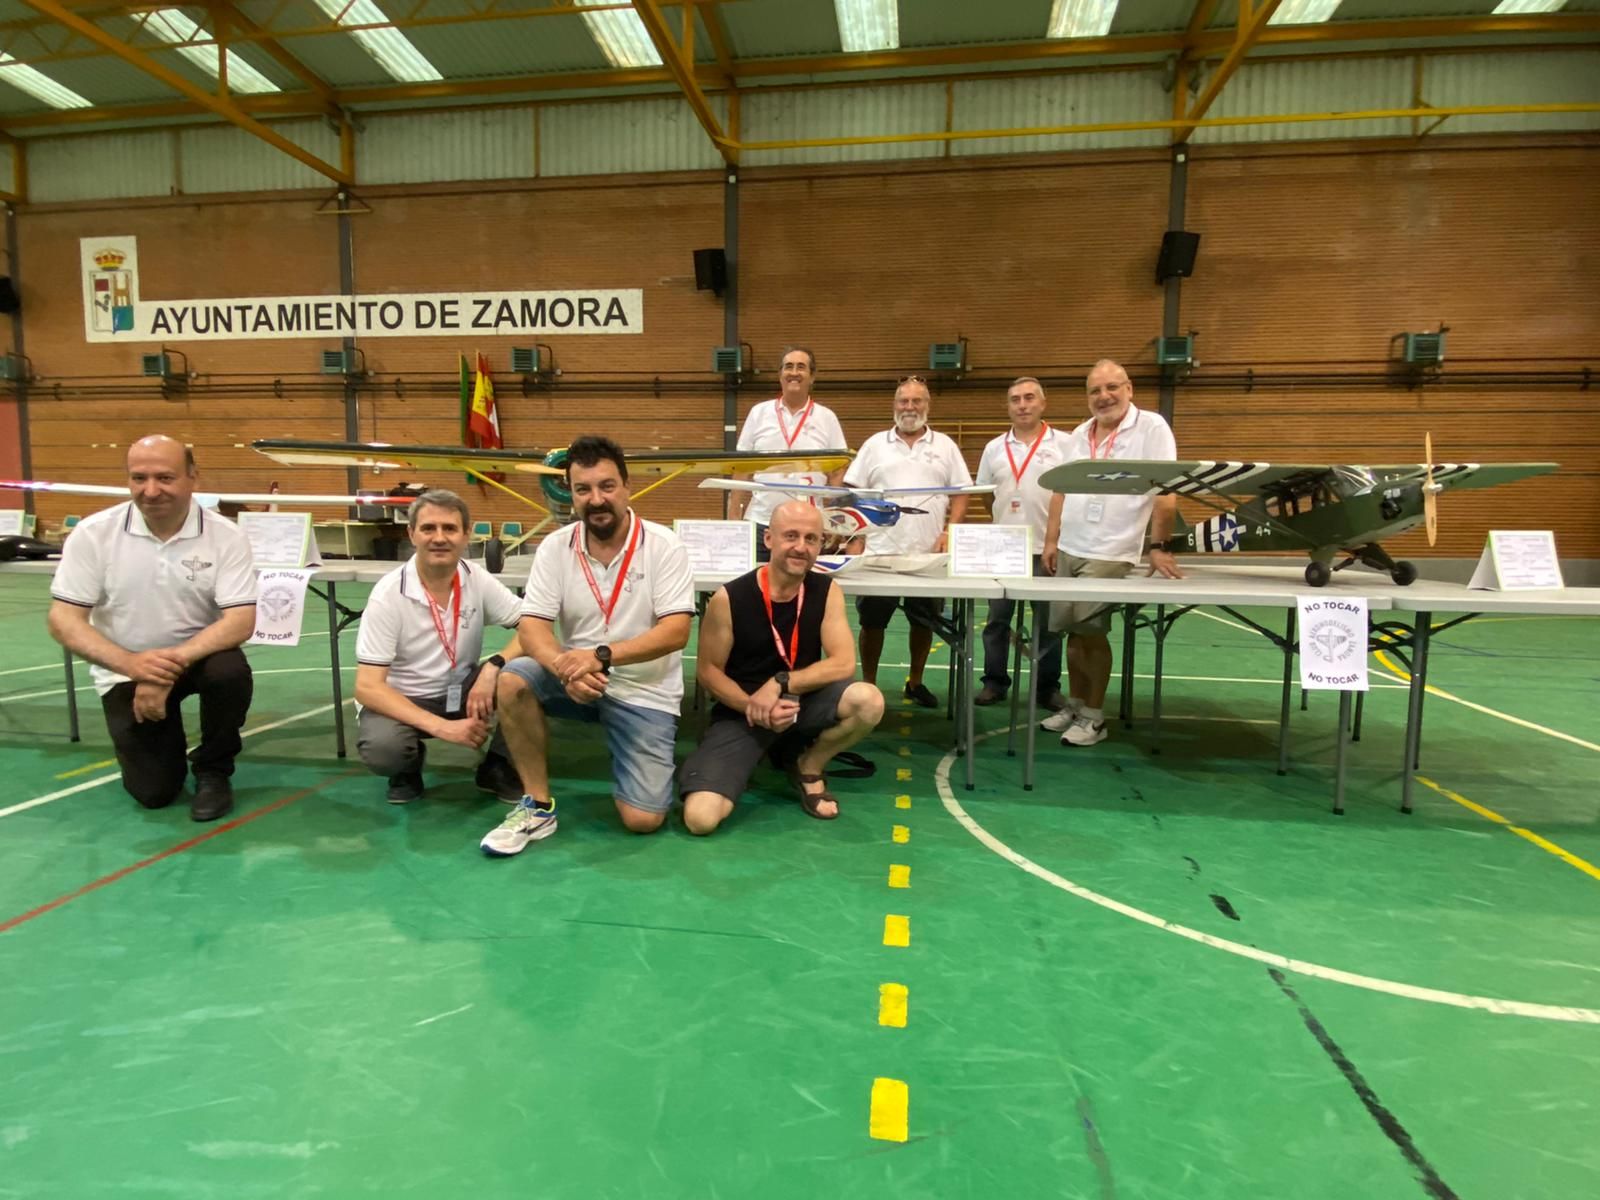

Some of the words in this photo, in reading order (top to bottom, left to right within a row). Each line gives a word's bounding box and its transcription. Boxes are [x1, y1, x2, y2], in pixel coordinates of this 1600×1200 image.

[151, 300, 404, 335] AYUNTAMIENTO
[414, 300, 460, 330] DE
[472, 297, 629, 330] ZAMORA
[1188, 532, 1197, 547] 6
[263, 572, 276, 581] NO
[279, 572, 305, 581] TOCAR
[1304, 603, 1320, 613] NO
[1323, 602, 1360, 614] TOCAR
[255, 630, 266, 639] NO
[267, 631, 293, 640] TOCAR
[1308, 672, 1323, 683] NO
[1325, 673, 1359, 684] TOCAR
